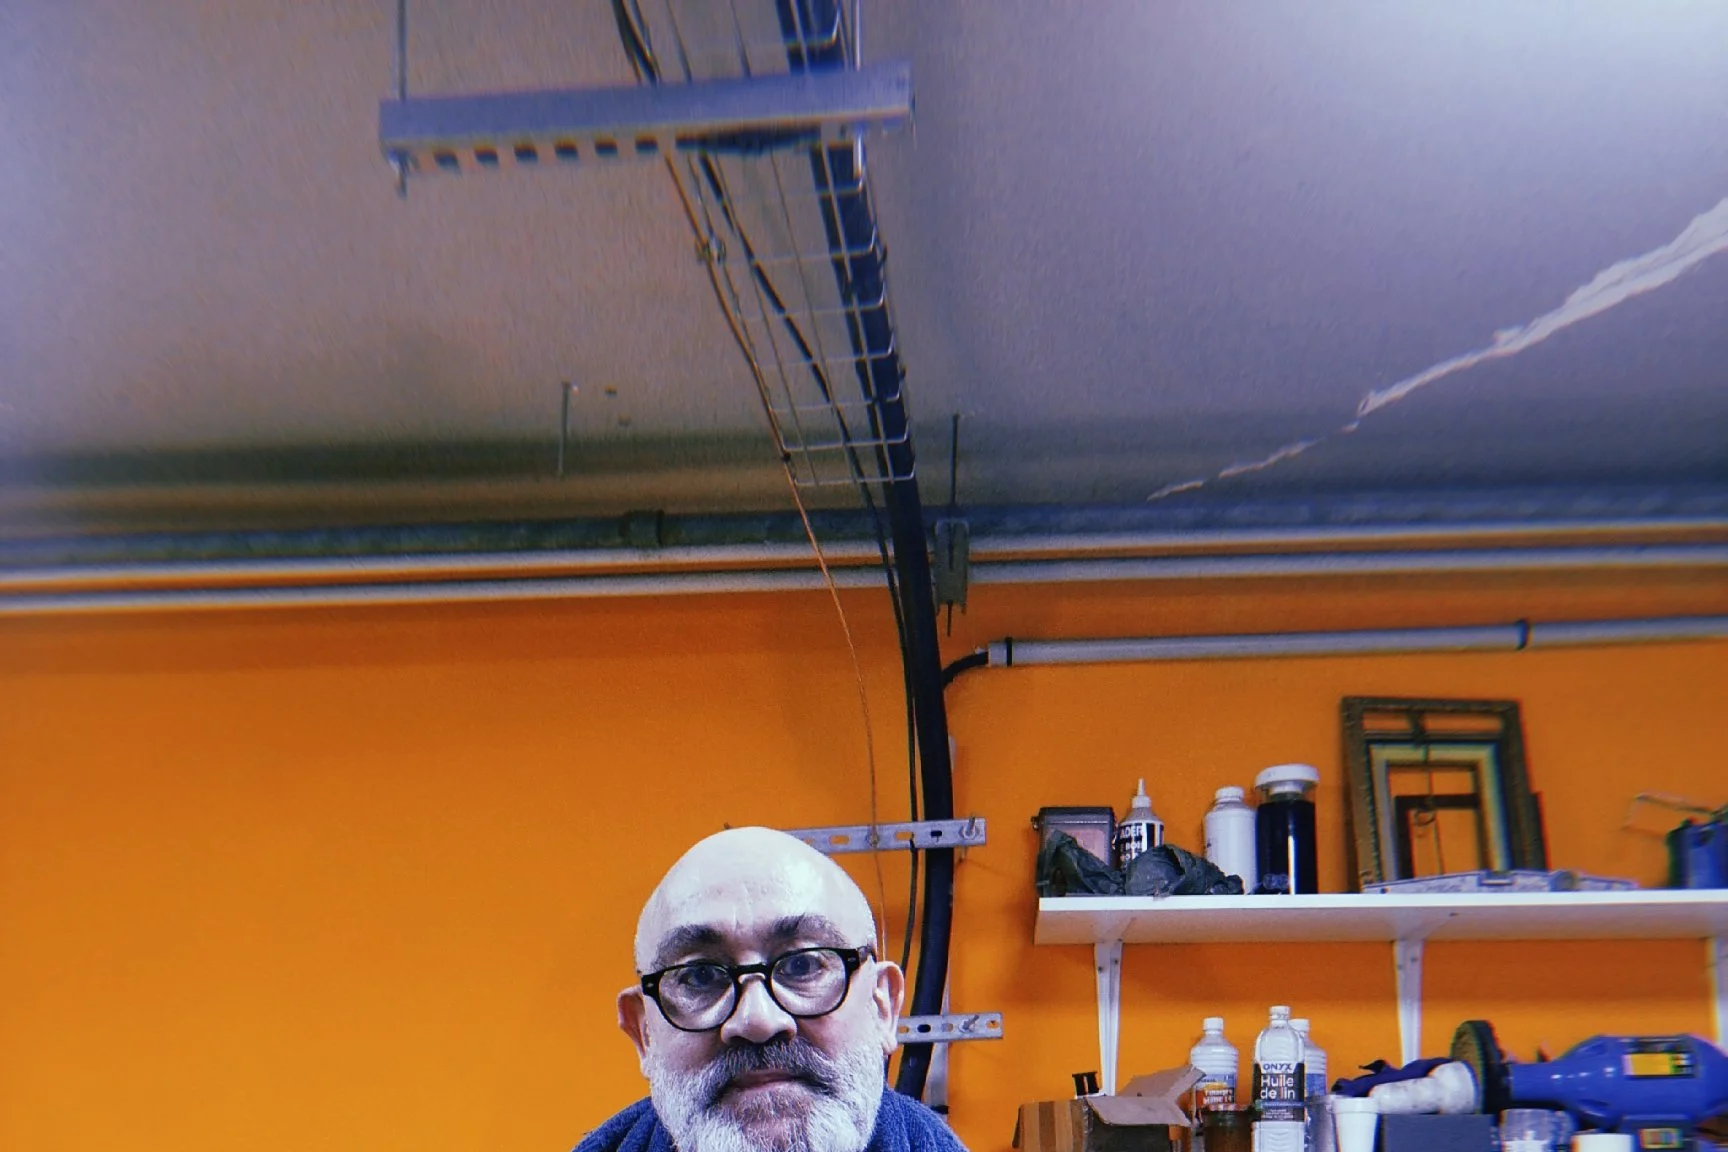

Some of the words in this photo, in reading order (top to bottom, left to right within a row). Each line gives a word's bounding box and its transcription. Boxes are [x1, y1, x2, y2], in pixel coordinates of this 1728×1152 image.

[1263, 1063, 1292, 1071] ONYX
[1261, 1074, 1294, 1087] Huile
[1261, 1087, 1277, 1099] de
[1281, 1087, 1295, 1099] lin
